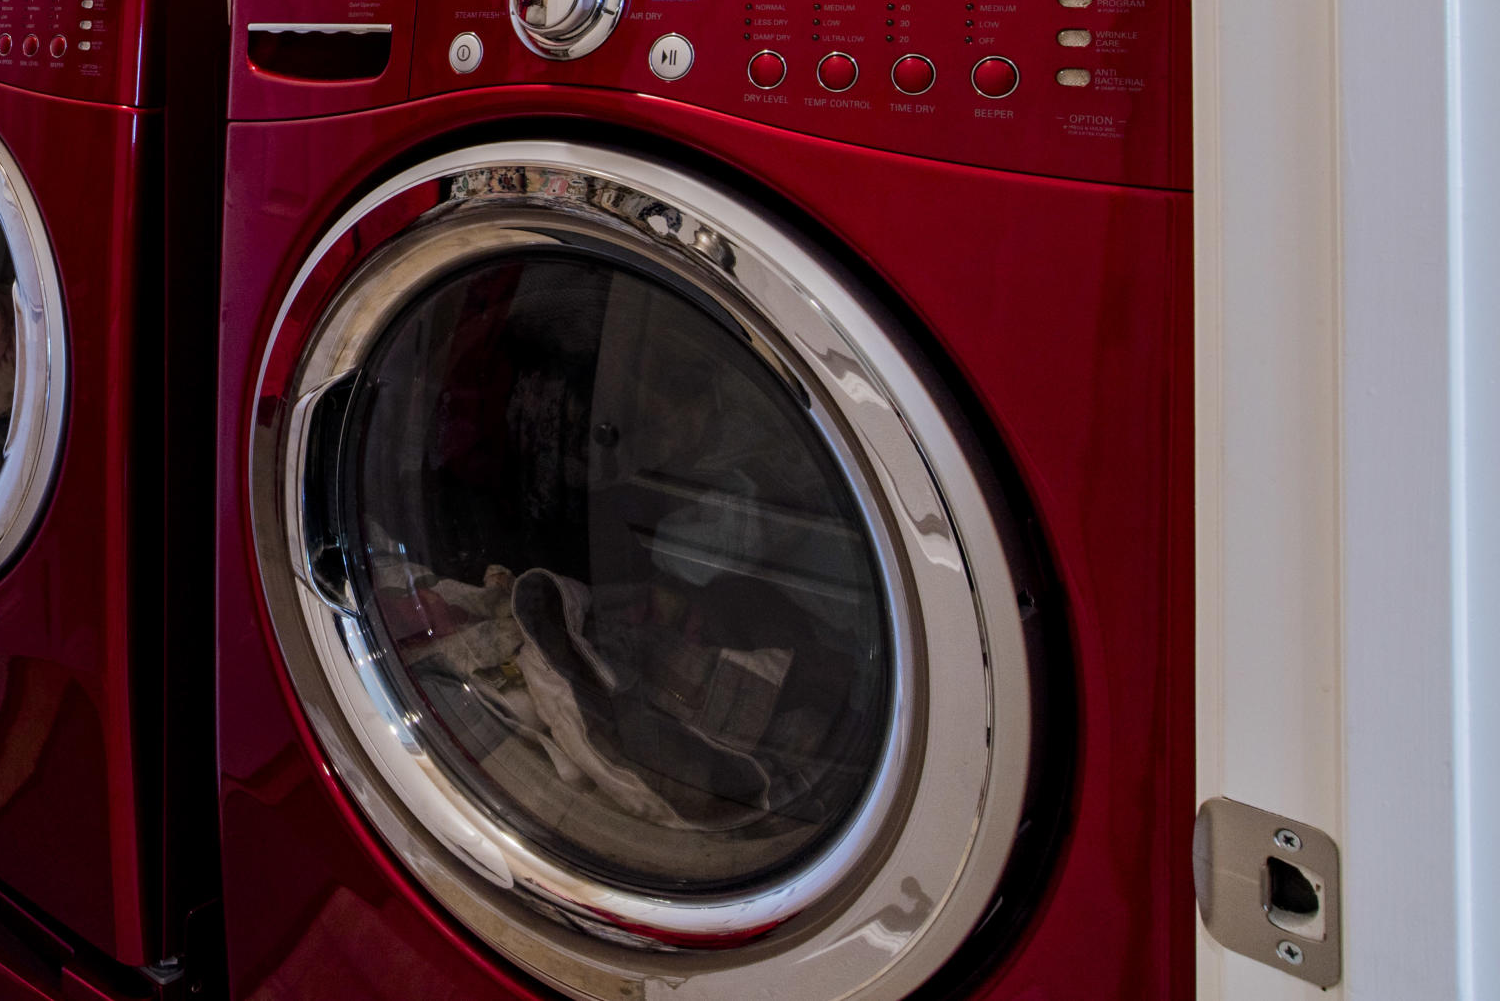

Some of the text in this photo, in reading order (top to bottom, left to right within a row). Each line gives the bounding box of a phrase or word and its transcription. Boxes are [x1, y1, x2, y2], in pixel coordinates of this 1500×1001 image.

[900, 4, 911, 12] 40
[1097, 0, 1146, 8] PROGRAM
[979, 4, 1017, 13] MEDIUM
[454, 11, 477, 19] STEAM
[630, 12, 663, 21] AIR DRY
[822, 19, 841, 27] LOW
[899, 20, 910, 28] 30
[979, 21, 1000, 29] LOW
[753, 33, 791, 41] DAMP DRY
[847, 35, 865, 43] LOW
[1095, 31, 1138, 40] WRINKLE
[899, 36, 910, 44] 20
[978, 37, 996, 45] OFF
[1095, 39, 1120, 47] CARE
[1094, 68, 1117, 77] ANTI
[1094, 77, 1145, 87] BACTERIAL
[743, 94, 789, 104] DRY LEVEL
[804, 97, 871, 110] TEMP CONTROL
[890, 103, 935, 114] TIME DRY
[974, 109, 1014, 120] BEEPER
[1069, 114, 1113, 125] OPTION
